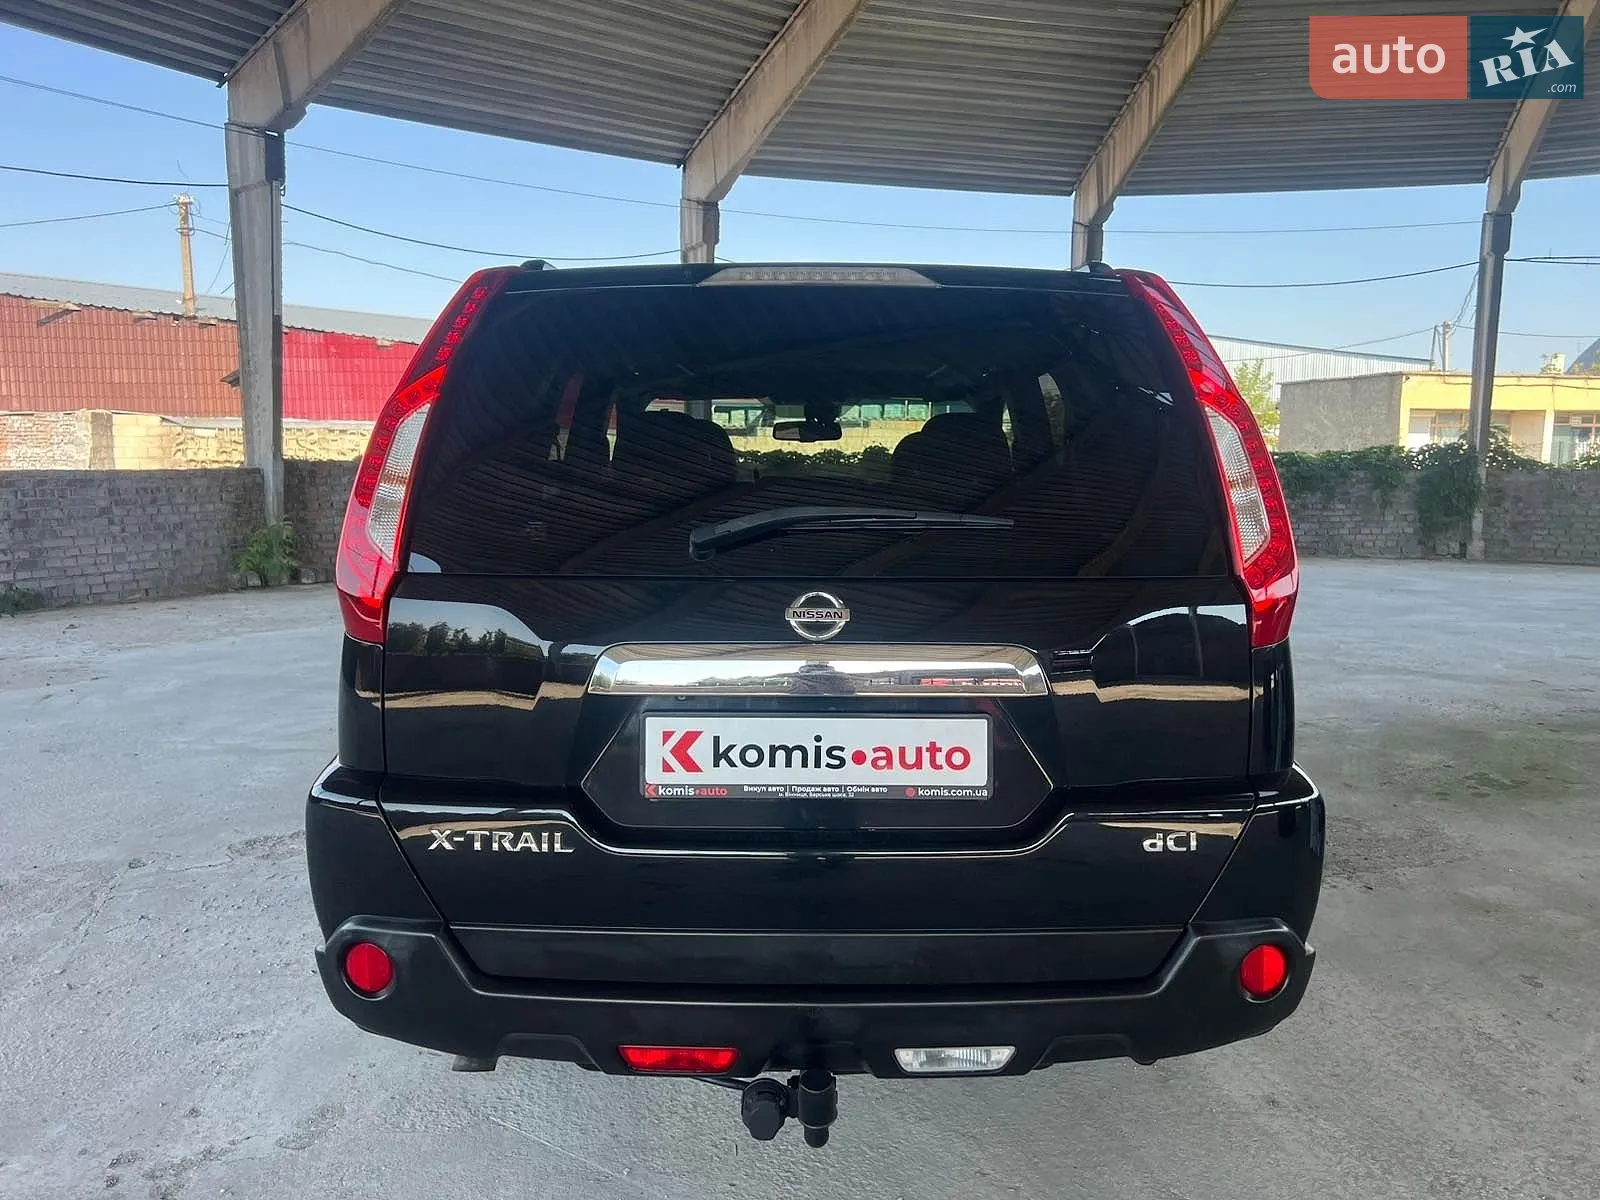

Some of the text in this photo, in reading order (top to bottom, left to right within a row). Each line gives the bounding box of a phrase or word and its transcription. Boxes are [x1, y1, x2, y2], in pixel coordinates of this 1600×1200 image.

[792, 610, 843, 619] NISSAN
[791, 785, 822, 793] Продаж
[918, 787, 988, 797] komis.com.ua
[427, 829, 576, 853] X-TRAIL
